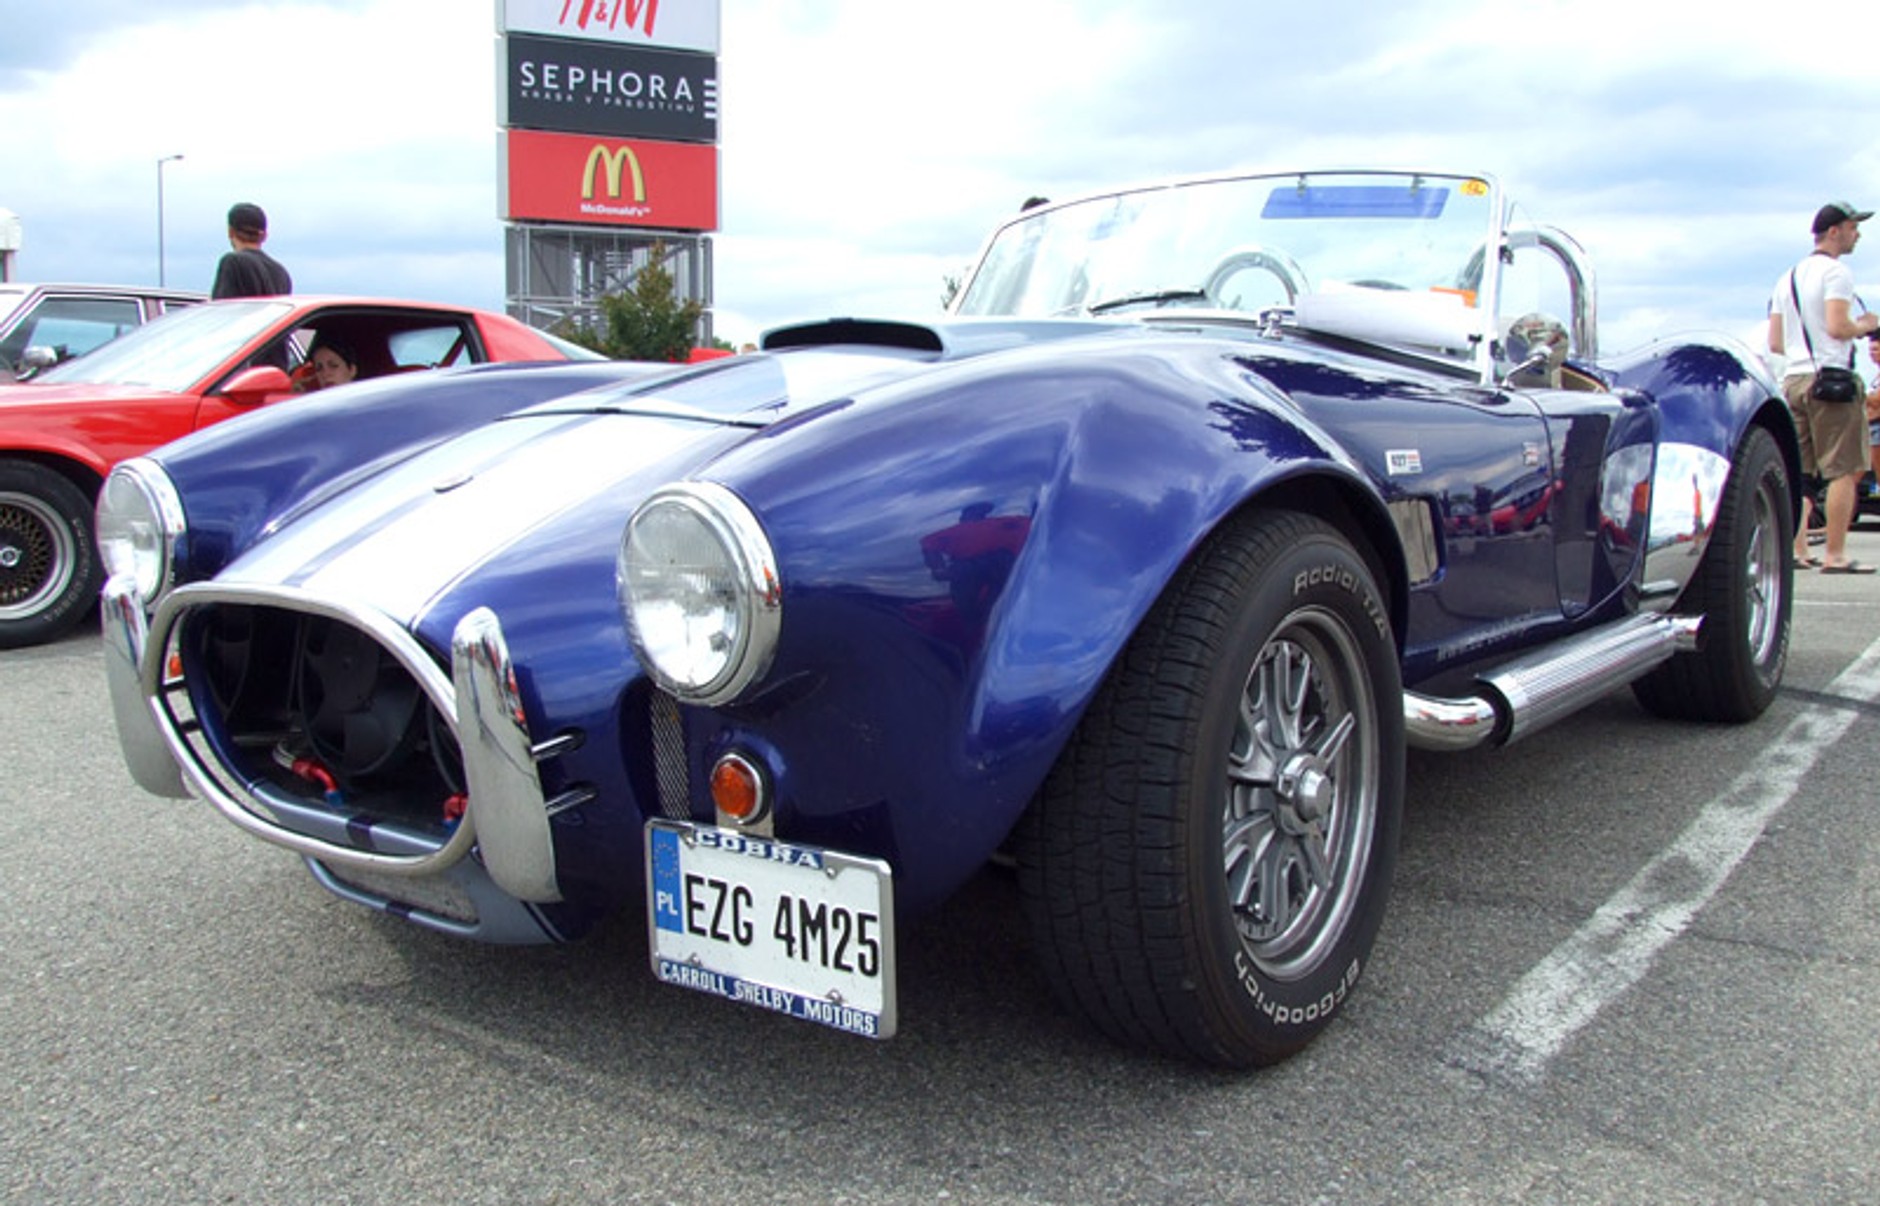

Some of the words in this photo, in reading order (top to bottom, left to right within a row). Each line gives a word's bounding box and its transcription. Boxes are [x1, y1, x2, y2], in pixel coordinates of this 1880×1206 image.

[519, 61, 694, 101] SEPHORA
[694, 831, 820, 868] COBRA
[656, 890, 678, 916] PL
[685, 873, 754, 947] EZG
[773, 894, 880, 977] 4M25
[660, 962, 727, 996] CARROLL
[734, 982, 794, 1014] SHELBY
[803, 1003, 876, 1035] MOTORS
